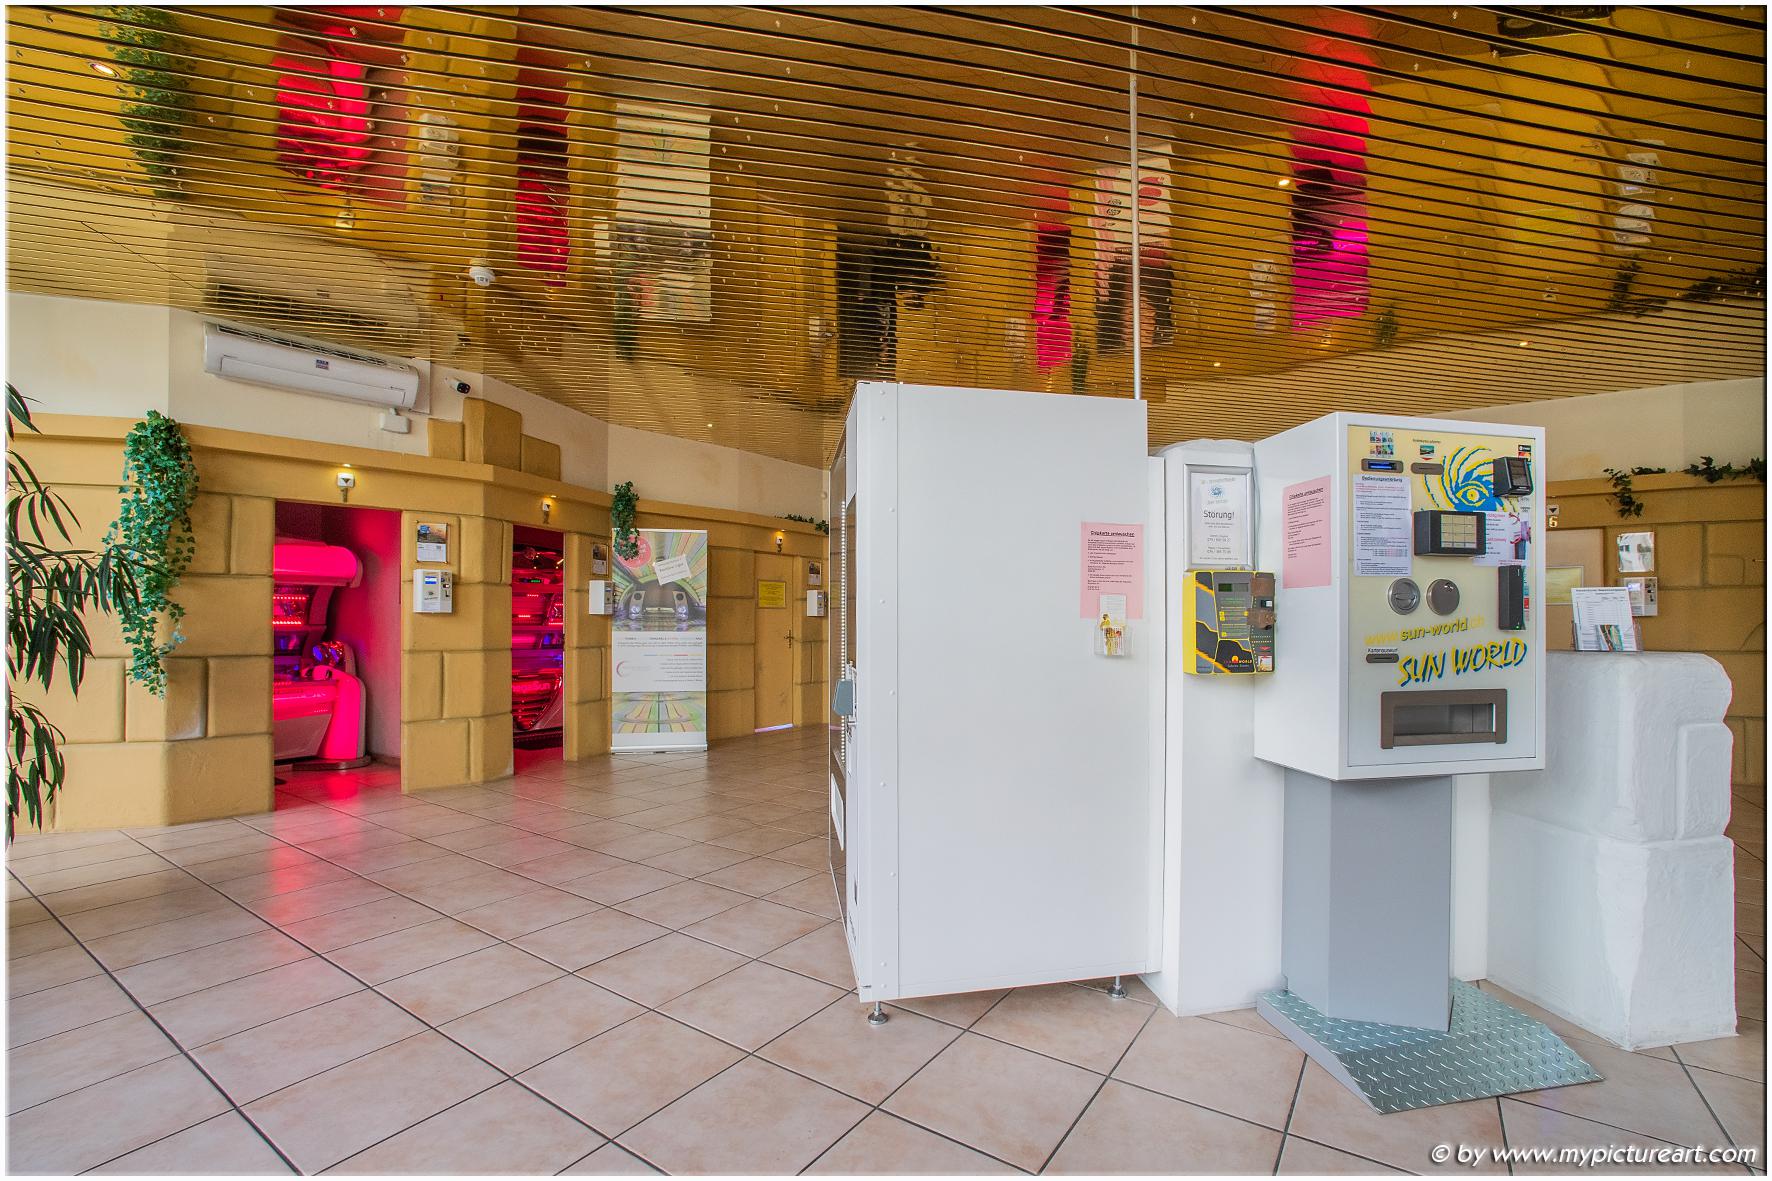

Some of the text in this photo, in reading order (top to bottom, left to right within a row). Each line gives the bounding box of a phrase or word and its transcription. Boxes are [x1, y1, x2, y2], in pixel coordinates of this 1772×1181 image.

[1548, 515, 1558, 528] 6
[1398, 637, 1528, 687] SUN WORLD
